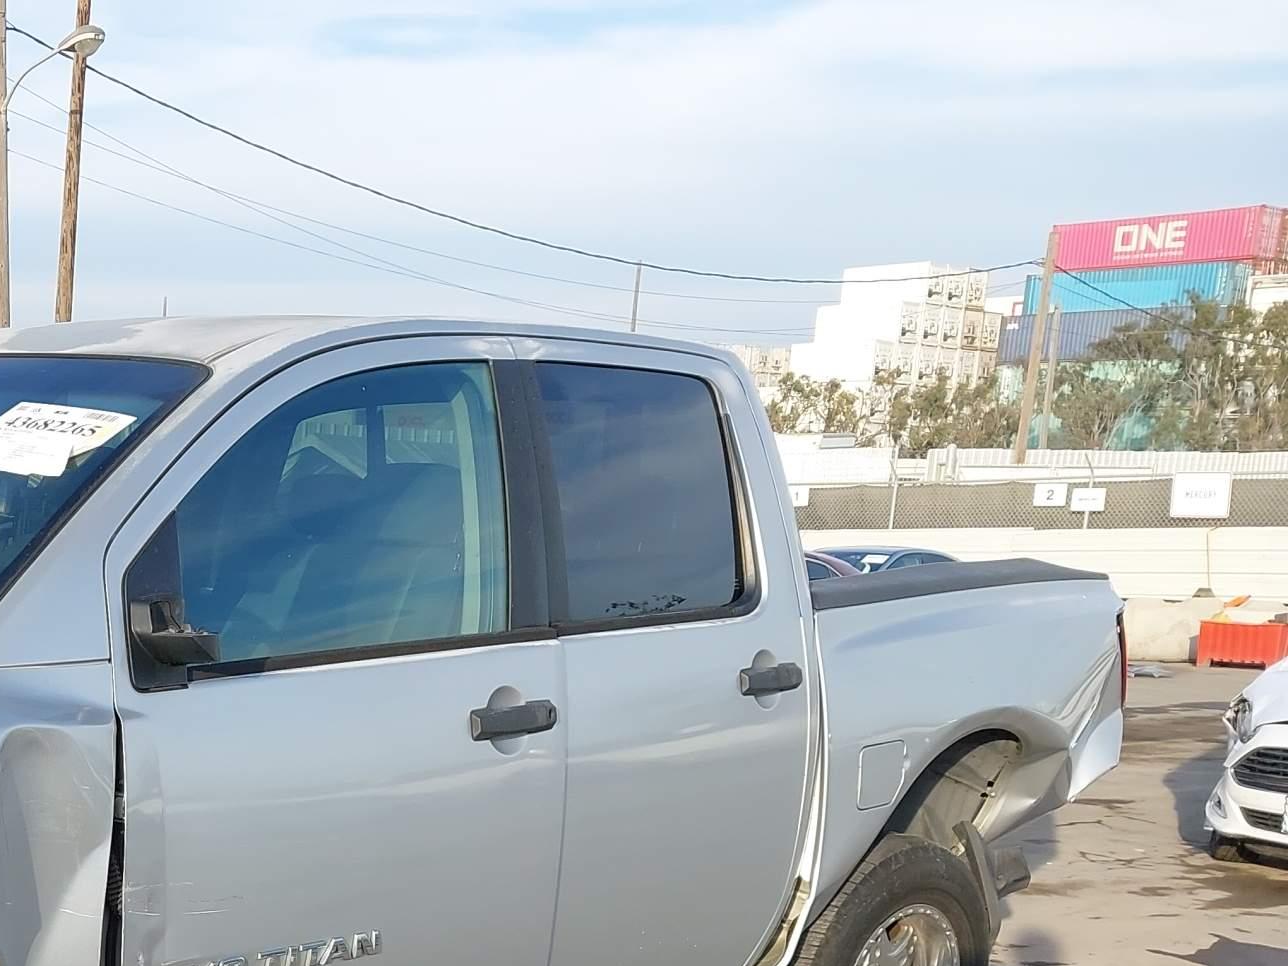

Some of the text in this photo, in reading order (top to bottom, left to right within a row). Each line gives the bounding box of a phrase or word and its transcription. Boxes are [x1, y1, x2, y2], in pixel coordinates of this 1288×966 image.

[1113, 220, 1188, 253] ONE
[5, 415, 103, 438] 43682265
[1046, 489, 1055, 501] 2
